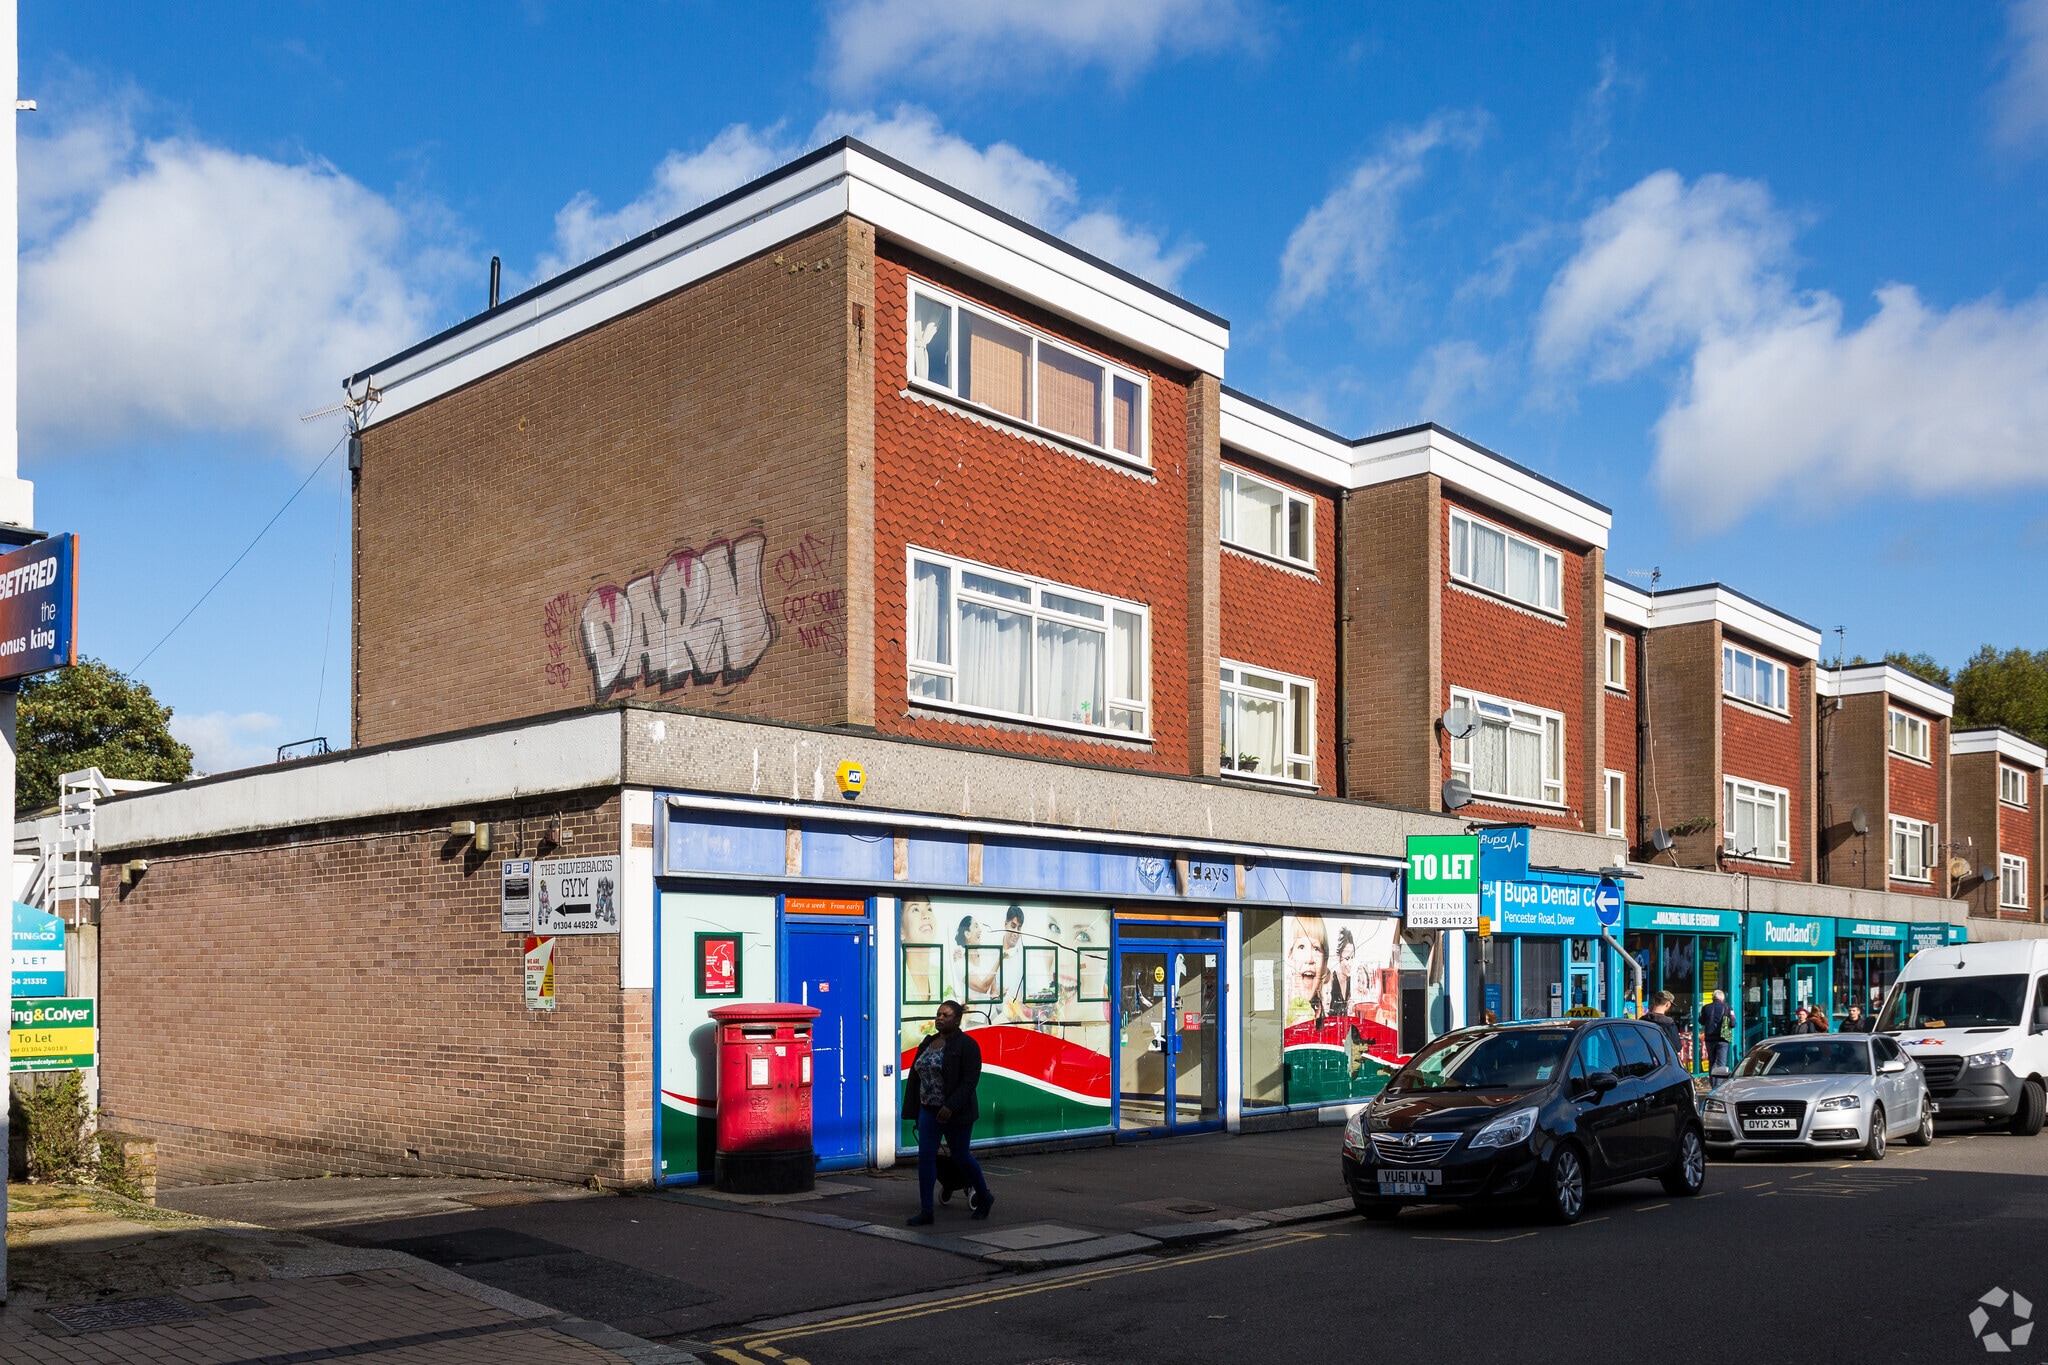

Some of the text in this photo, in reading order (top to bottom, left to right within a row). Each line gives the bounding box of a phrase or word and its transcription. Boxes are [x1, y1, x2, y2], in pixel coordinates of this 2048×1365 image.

[0, 556, 57, 599] BETFRED
[41, 601, 56, 622] the
[30, 628, 56, 649] king
[1480, 834, 1507, 846] Bupa
[540, 860, 613, 876] THE SILVERBACKS
[1411, 854, 1474, 881] TO LET
[561, 877, 589, 898] GYM
[1504, 880, 1538, 907] Bupa
[1541, 883, 1580, 907] Dental
[791, 900, 804, 910] days
[811, 901, 825, 909] week
[830, 902, 845, 910] From
[1412, 902, 1472, 910] CRITTENDEN
[1412, 917, 1473, 925] 01843 841123
[1504, 910, 1575, 926] Pencester Road, Dover
[553, 920, 598, 930] 01304 449292
[1765, 920, 1810, 943] Poundland
[1572, 938, 1588, 961] 64
[23, 957, 47, 965] LET
[1569, 1009, 1594, 1018] TAXI
[18, 1033, 52, 1043] To Let
[21, 1045, 42, 1053] 01304
[1772, 1119, 1790, 1128] XSM
[1384, 1170, 1408, 1183] VU61
